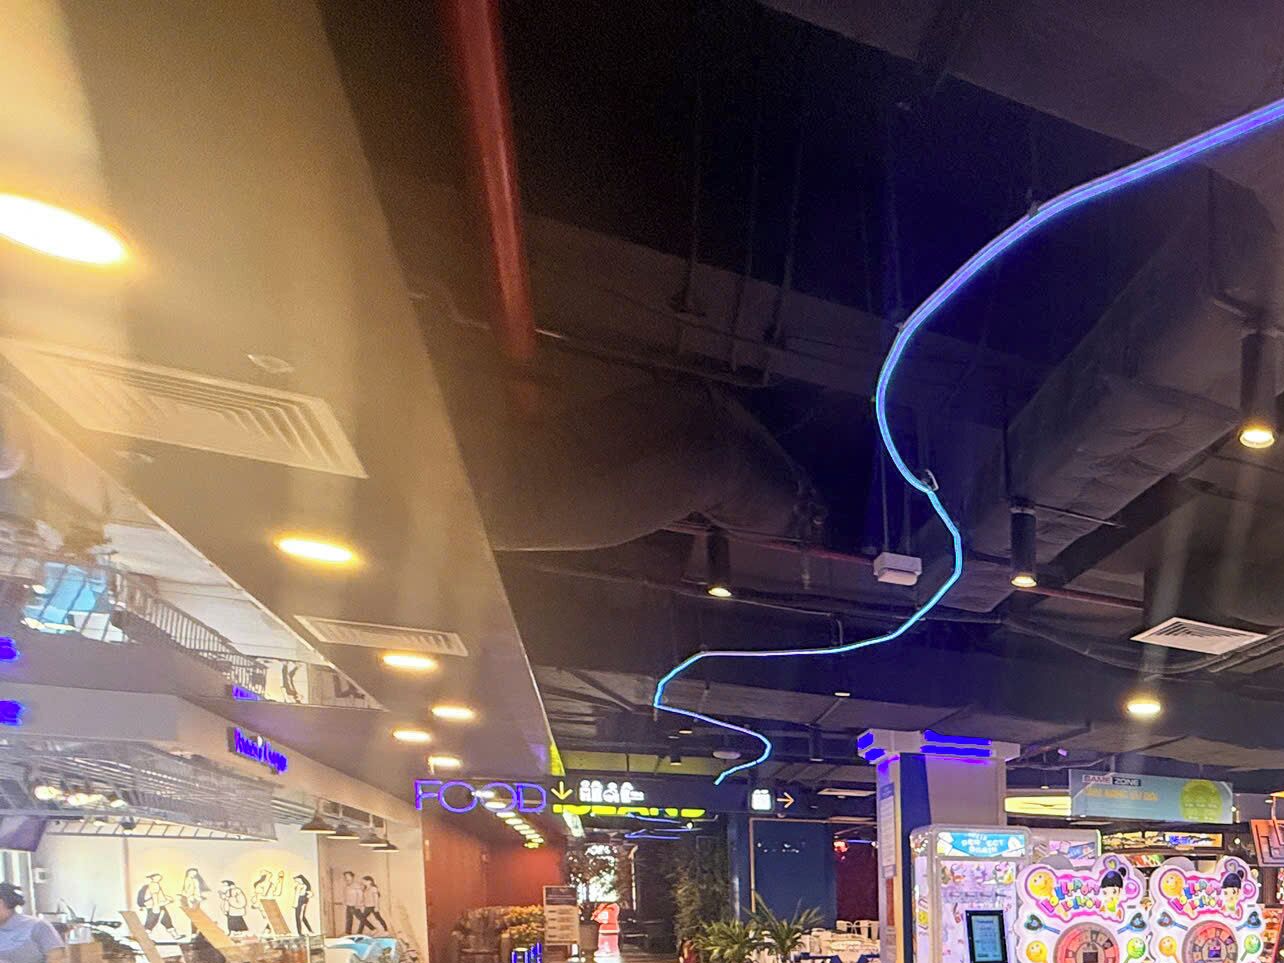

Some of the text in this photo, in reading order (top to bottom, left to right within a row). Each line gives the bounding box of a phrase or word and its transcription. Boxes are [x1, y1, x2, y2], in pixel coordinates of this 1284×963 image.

[1083, 775, 1139, 786] GAME ZONE
[414, 779, 547, 814] FOOD
